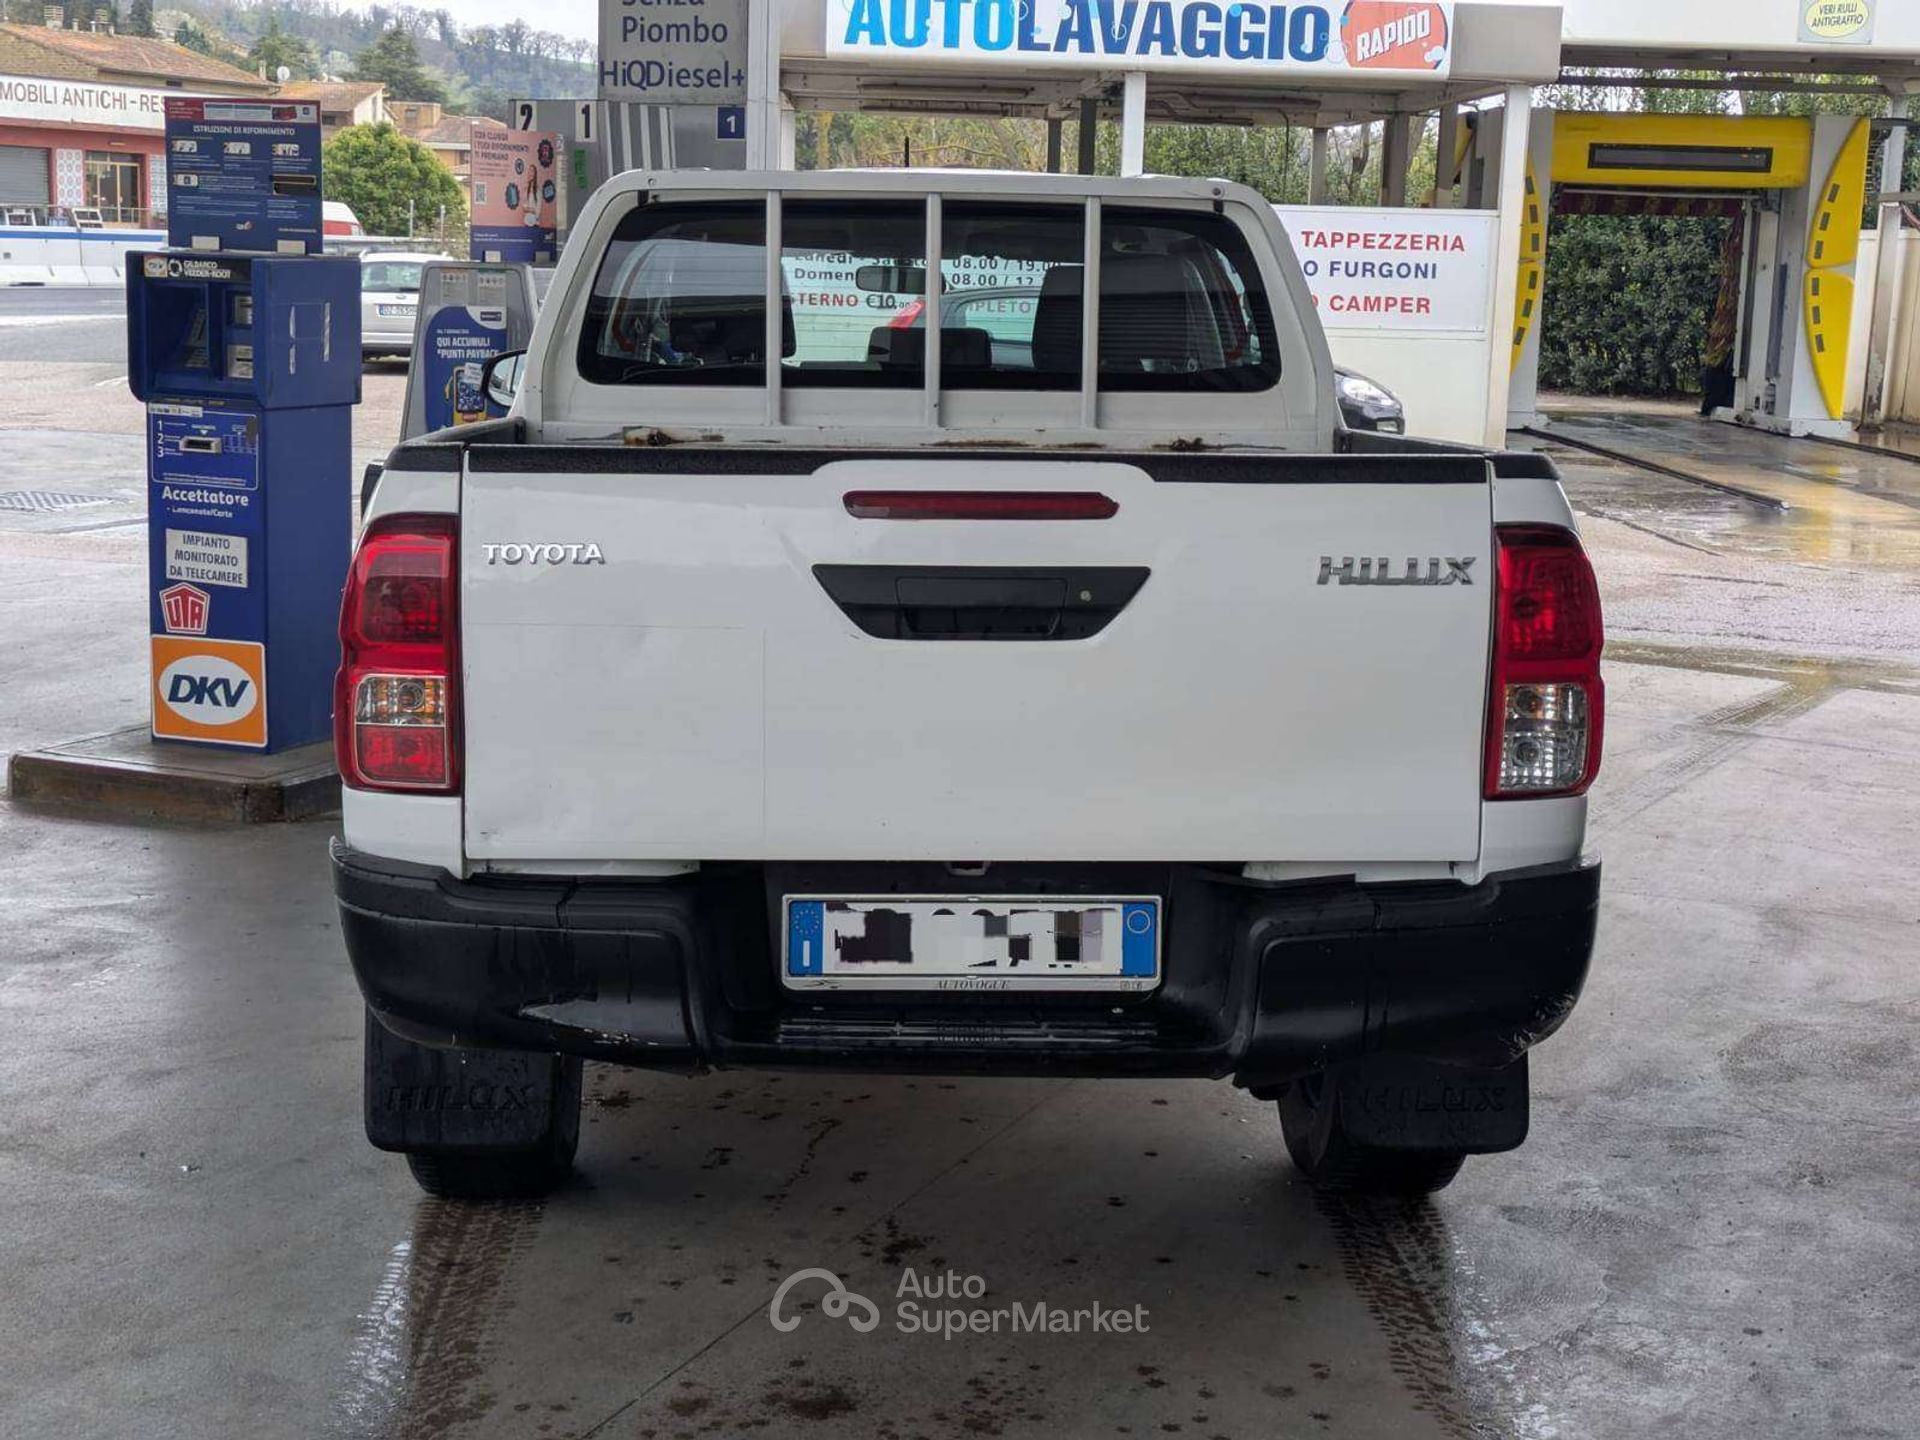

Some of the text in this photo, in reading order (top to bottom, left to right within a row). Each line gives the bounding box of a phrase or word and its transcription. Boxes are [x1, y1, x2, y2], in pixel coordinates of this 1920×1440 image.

[1819, 3, 1857, 15] VERI RULLI
[622, 15, 729, 43] Piombo
[1811, 14, 1864, 28] ANTIGRAFFIO
[843, 0, 1331, 62] AUTOLAVAGGIO
[1356, 10, 1432, 61] RAPIDO
[600, 60, 745, 90] HiQDiesel+
[0, 82, 58, 105] MOBILI
[62, 88, 127, 110] ANTICHI
[520, 104, 533, 130] 2
[581, 104, 591, 138] 1
[726, 115, 736, 134] 1
[1301, 231, 1465, 251] TAPPEZZERIA
[951, 273, 997, 286] 08.00
[1329, 261, 1437, 279] FURGONI
[791, 292, 859, 308] TERNO
[1330, 295, 1430, 314] CAMPER
[436, 337, 490, 347] QUI ACCUMULI
[157, 420, 163, 431] 1
[156, 433, 164, 444] 2
[157, 447, 164, 458] 3
[162, 486, 249, 507] Accettatore
[183, 534, 231, 550] IMPIANTO
[174, 549, 238, 567] MONITORATO
[482, 543, 605, 565] TOYOTA
[170, 565, 244, 584] DA TELECAMERE
[1316, 556, 1477, 586] HILUX
[165, 597, 206, 629] UTA
[168, 674, 249, 708] DKV
[387, 1085, 534, 1111] HILUX
